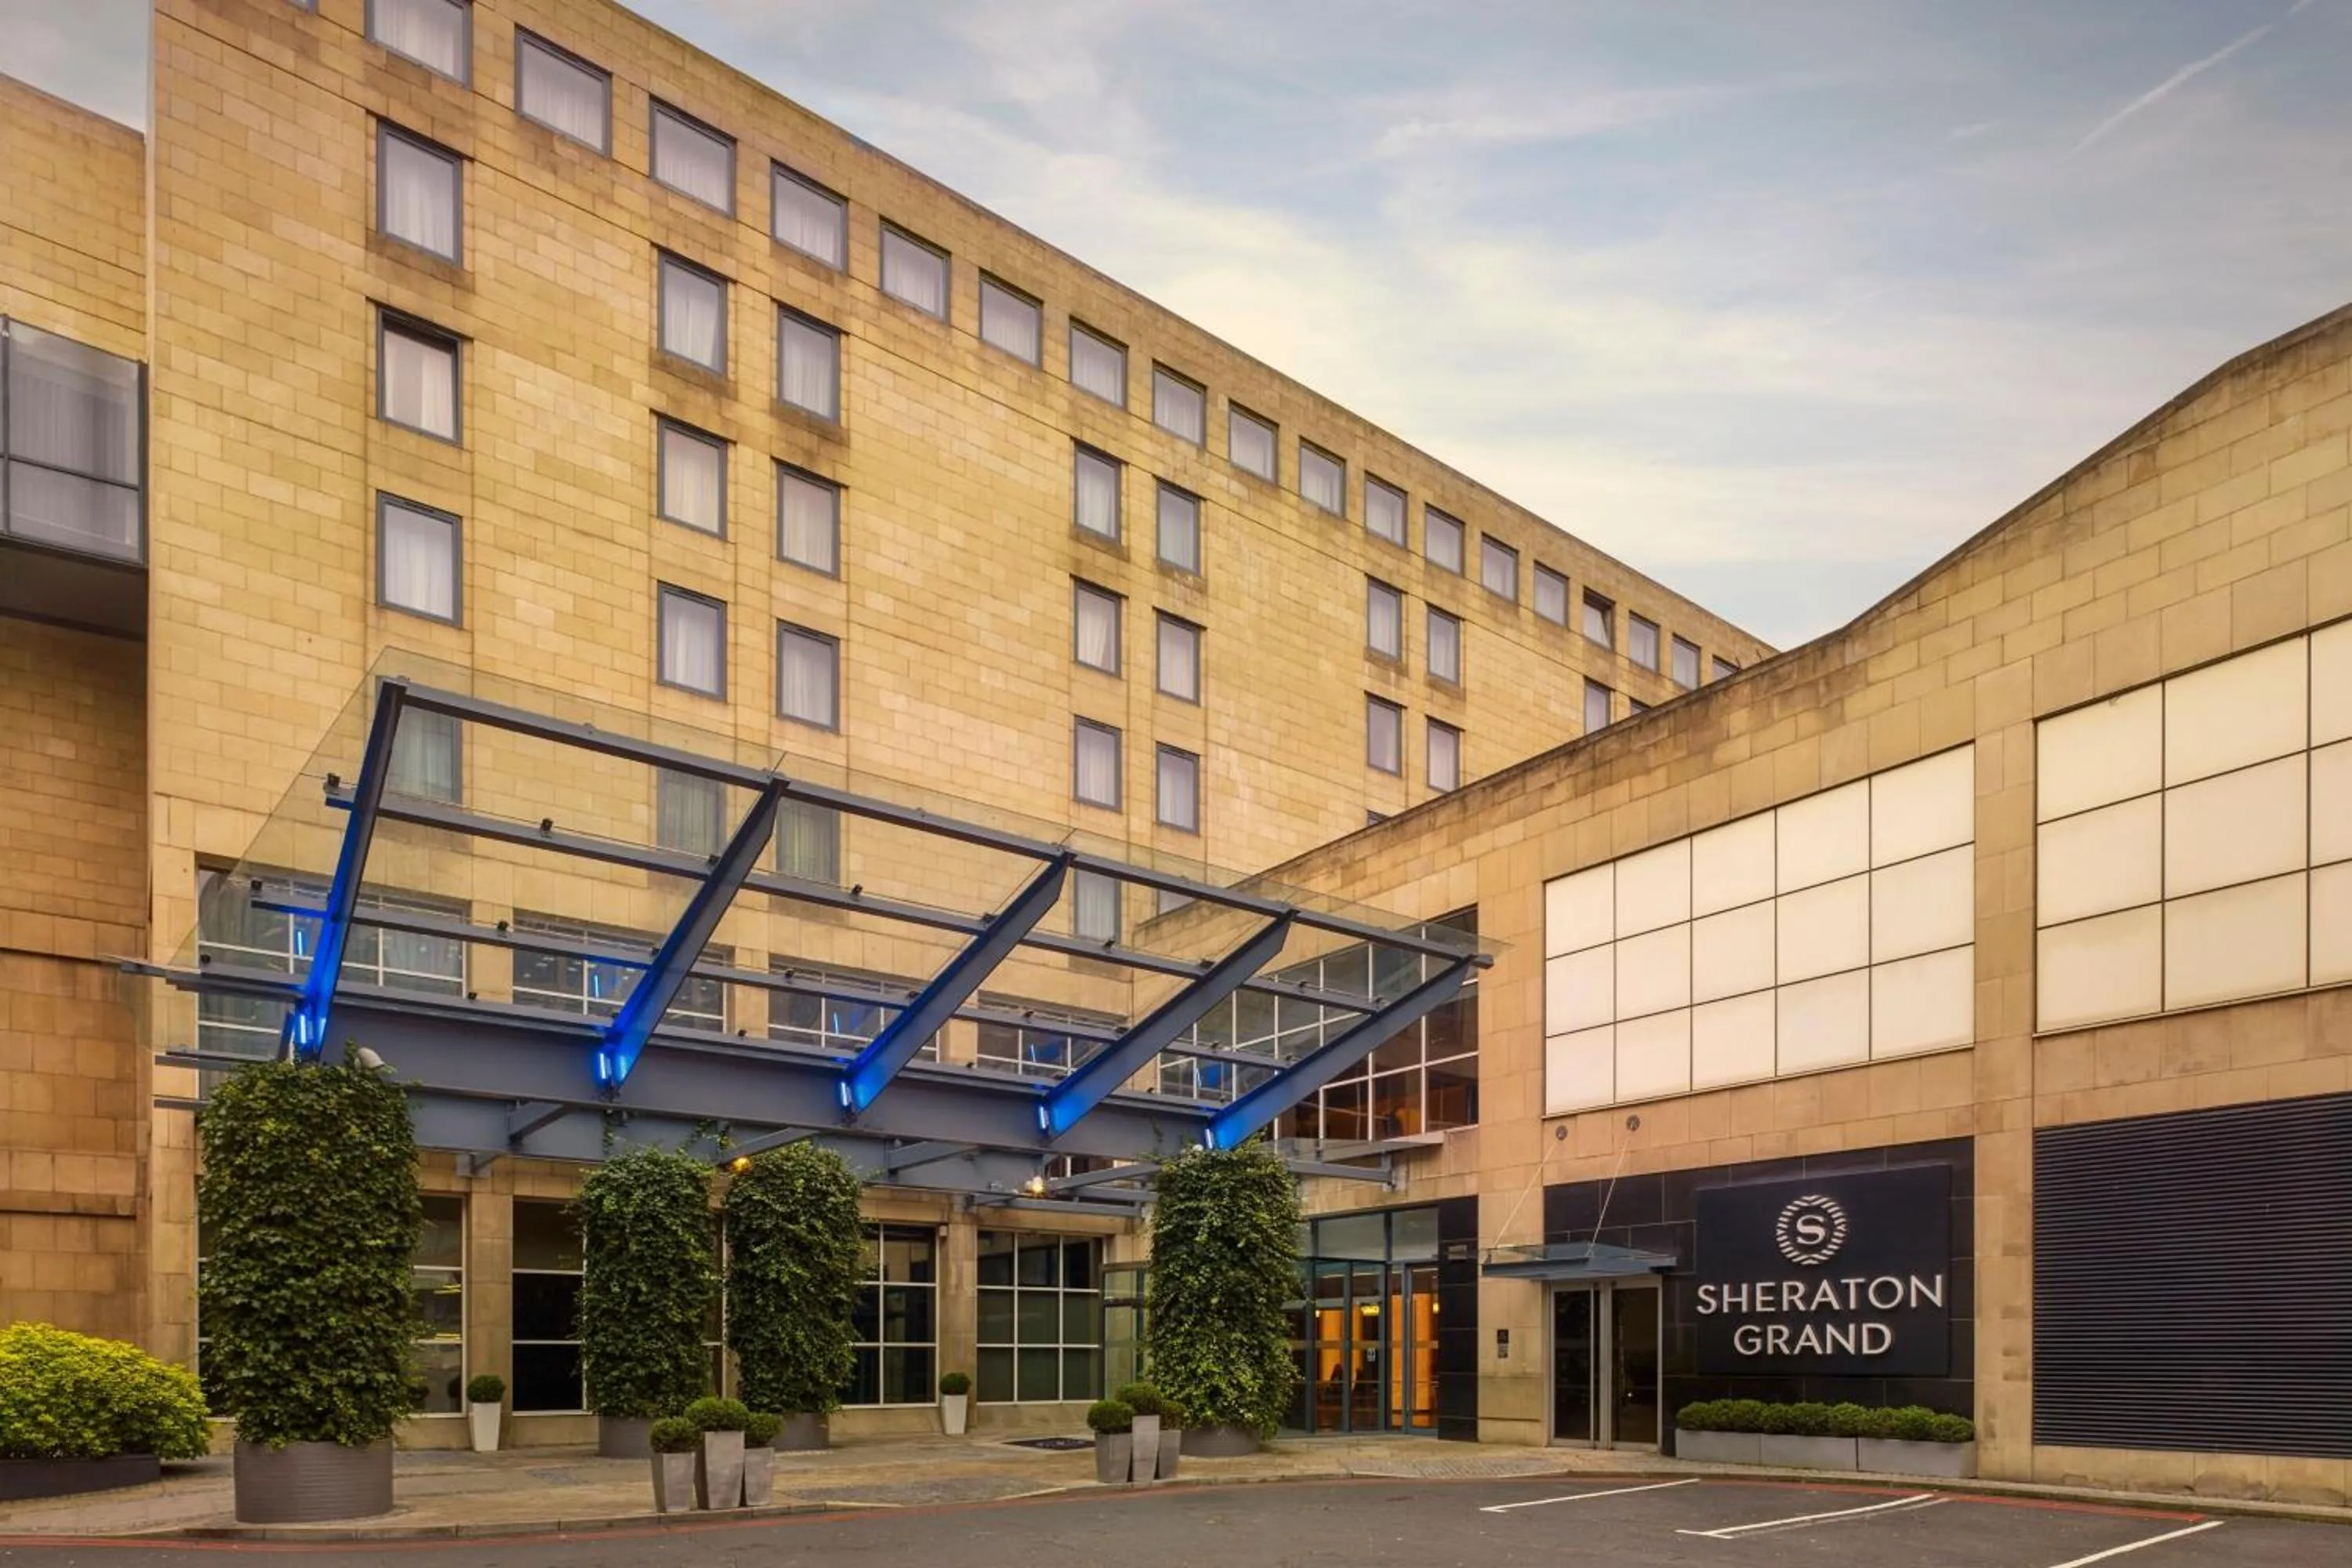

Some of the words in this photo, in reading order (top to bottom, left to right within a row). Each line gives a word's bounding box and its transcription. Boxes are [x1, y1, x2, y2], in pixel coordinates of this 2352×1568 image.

[1796, 1215, 1825, 1244] S
[1697, 1274, 1943, 1315] SHERATON
[1733, 1323, 1892, 1356] GRAND
